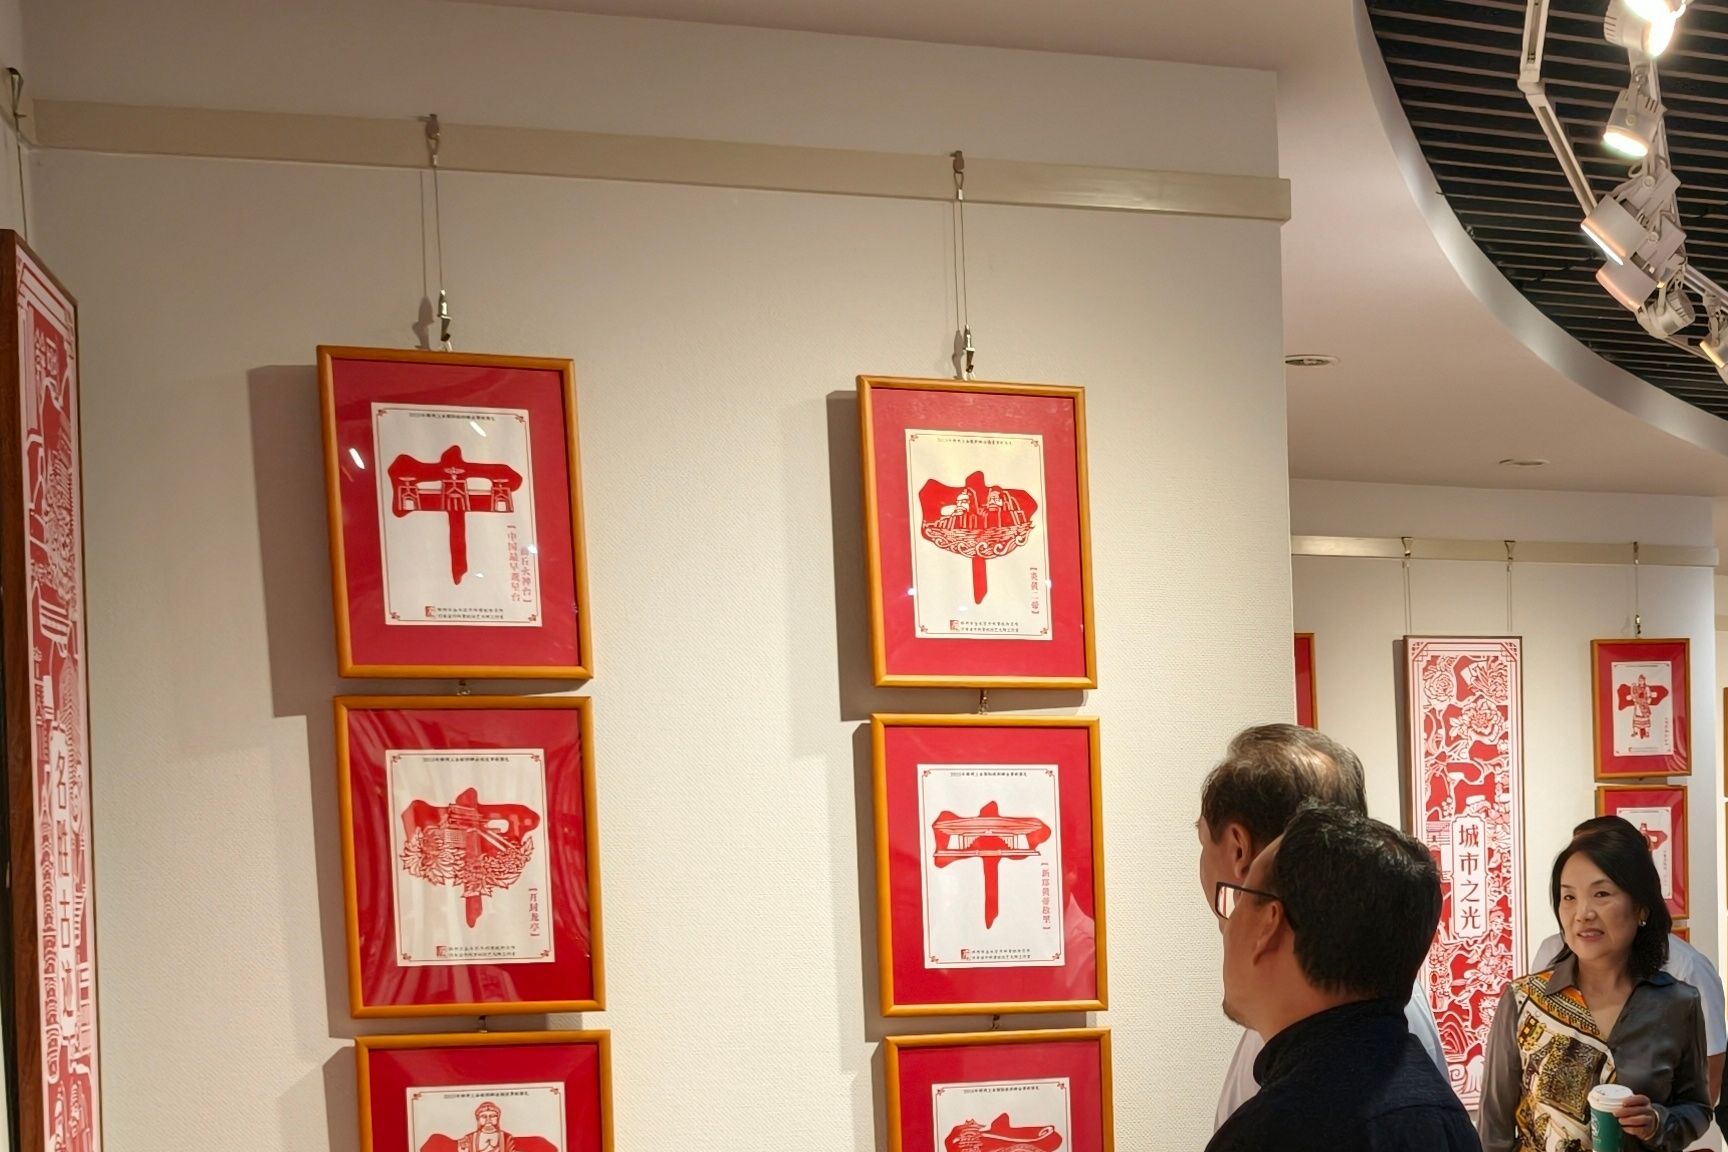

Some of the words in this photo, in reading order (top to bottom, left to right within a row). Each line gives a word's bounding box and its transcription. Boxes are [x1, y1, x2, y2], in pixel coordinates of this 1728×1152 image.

[56, 749, 75, 1017] 名胜古迹
[1458, 823, 1482, 932] 城市之光
